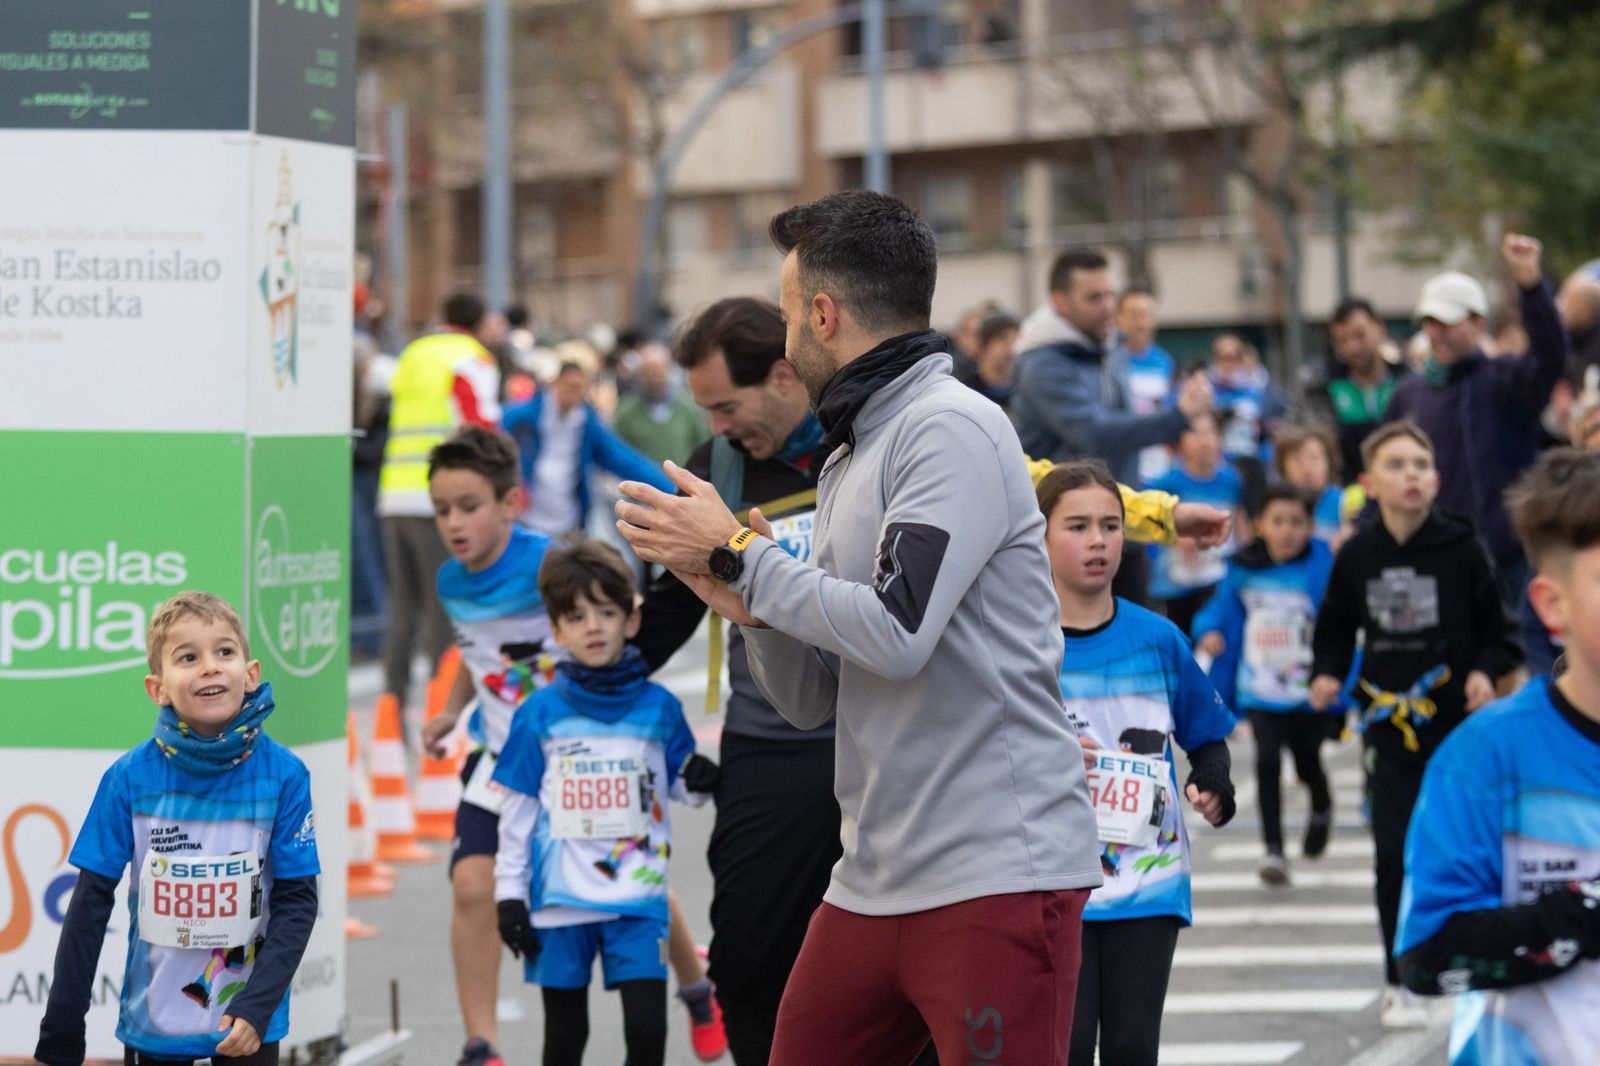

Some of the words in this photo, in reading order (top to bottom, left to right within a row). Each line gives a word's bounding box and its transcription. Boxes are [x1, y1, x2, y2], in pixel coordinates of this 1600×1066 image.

[49, 31, 151, 49] SOLUCIONES
[71, 53, 84, 69] A
[87, 52, 150, 70] MEDIDA
[0, 250, 41, 282] an
[54, 248, 222, 282] Estanislao
[0, 286, 20, 318] e
[31, 286, 143, 318] Kostka
[0, 541, 187, 585] cuelas
[1, 585, 160, 666] pila
[575, 758, 639, 773] SETEL
[1093, 756, 1158, 780] ETEL
[562, 776, 630, 811] 6688
[171, 859, 254, 878] SETEL
[154, 880, 238, 919] 6893
